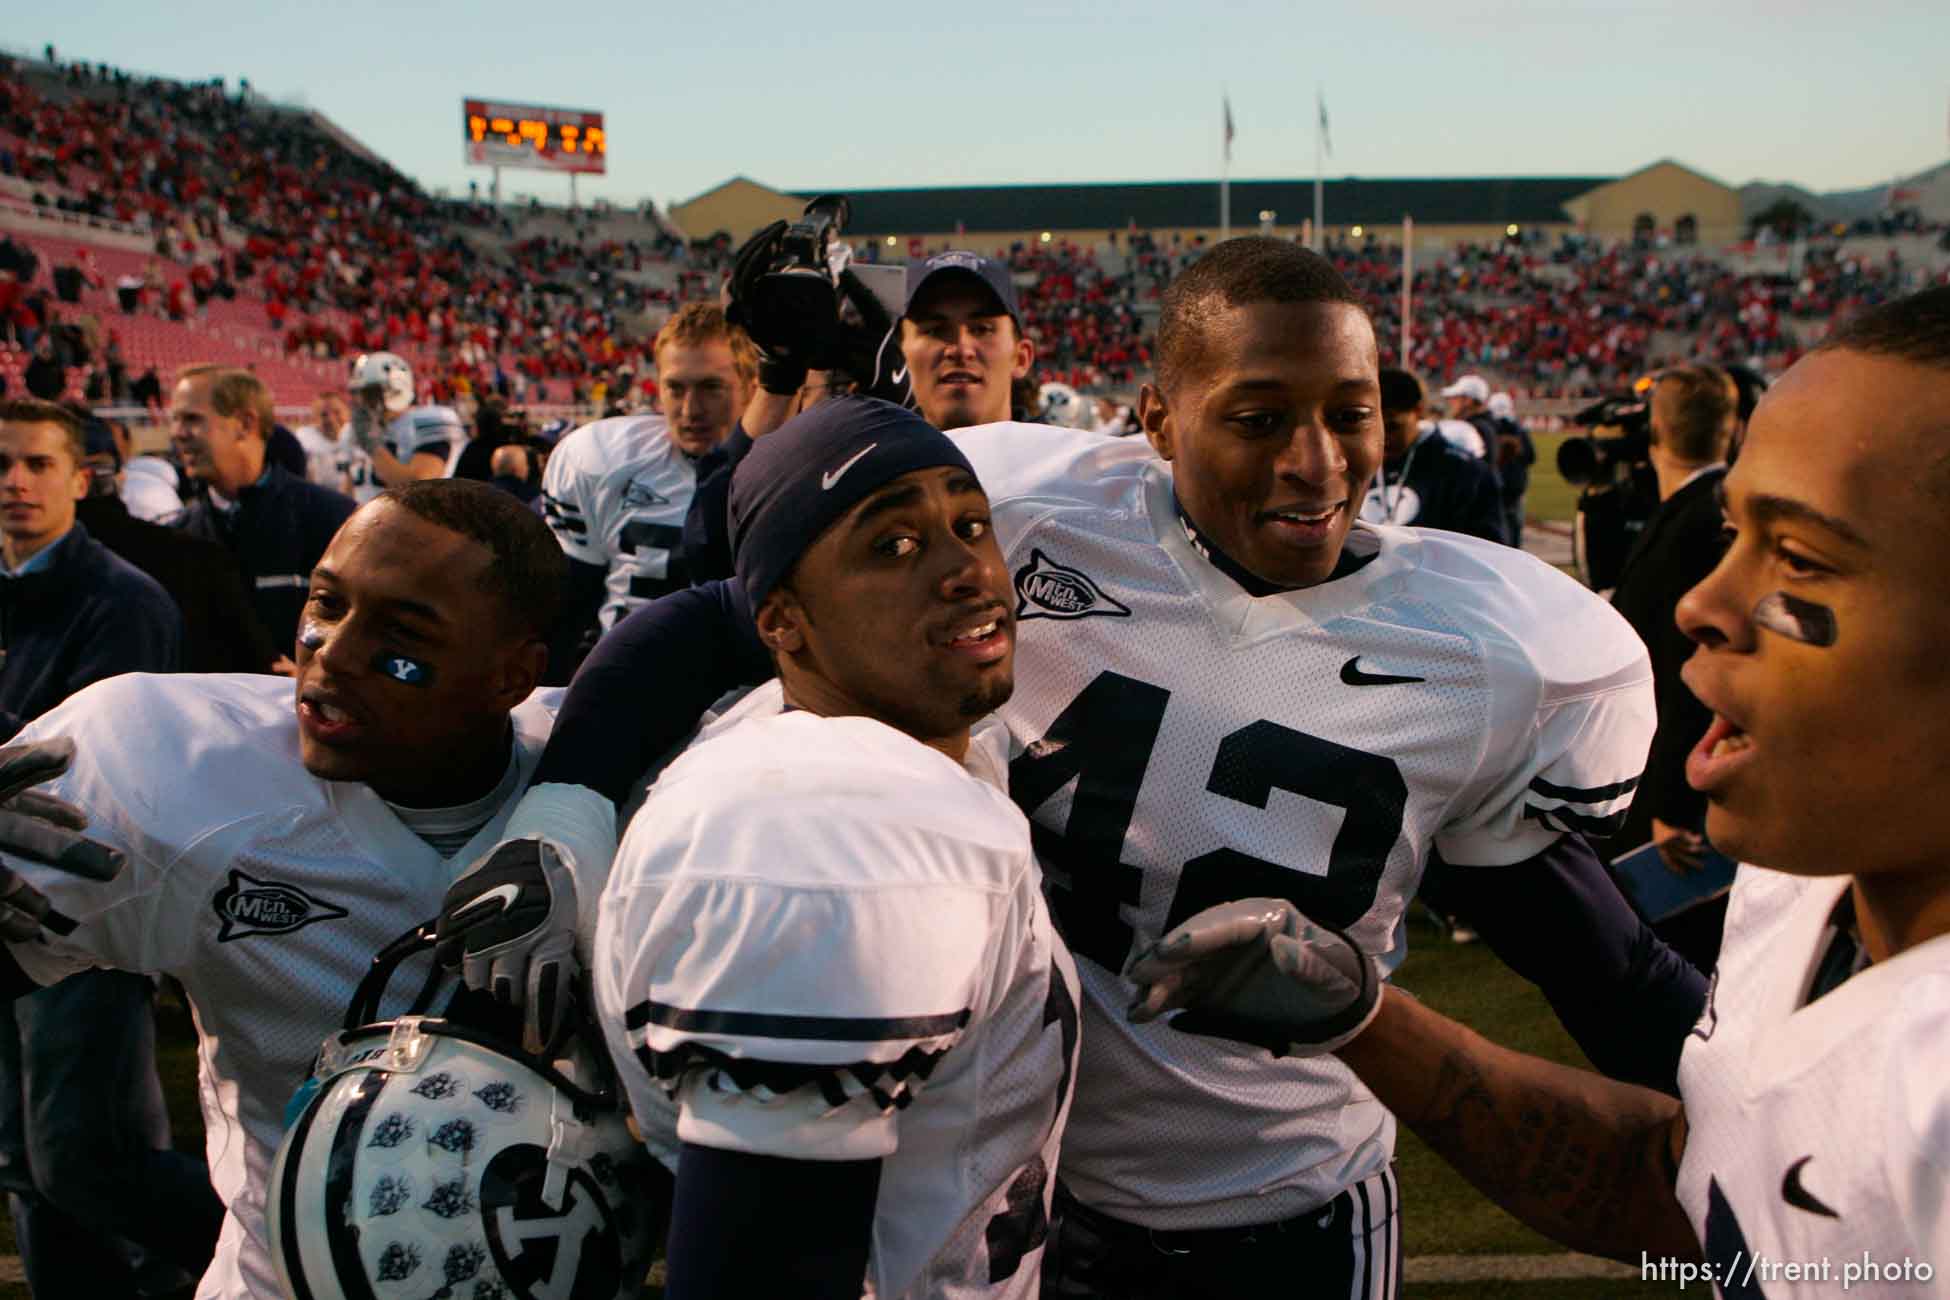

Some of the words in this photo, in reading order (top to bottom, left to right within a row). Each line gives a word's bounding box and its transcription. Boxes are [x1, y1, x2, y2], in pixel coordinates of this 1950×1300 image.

[1050, 596, 1086, 613] WEST
[393, 659, 417, 680] Y
[1009, 670, 1409, 975] 42
[260, 911, 298, 924] WEST
